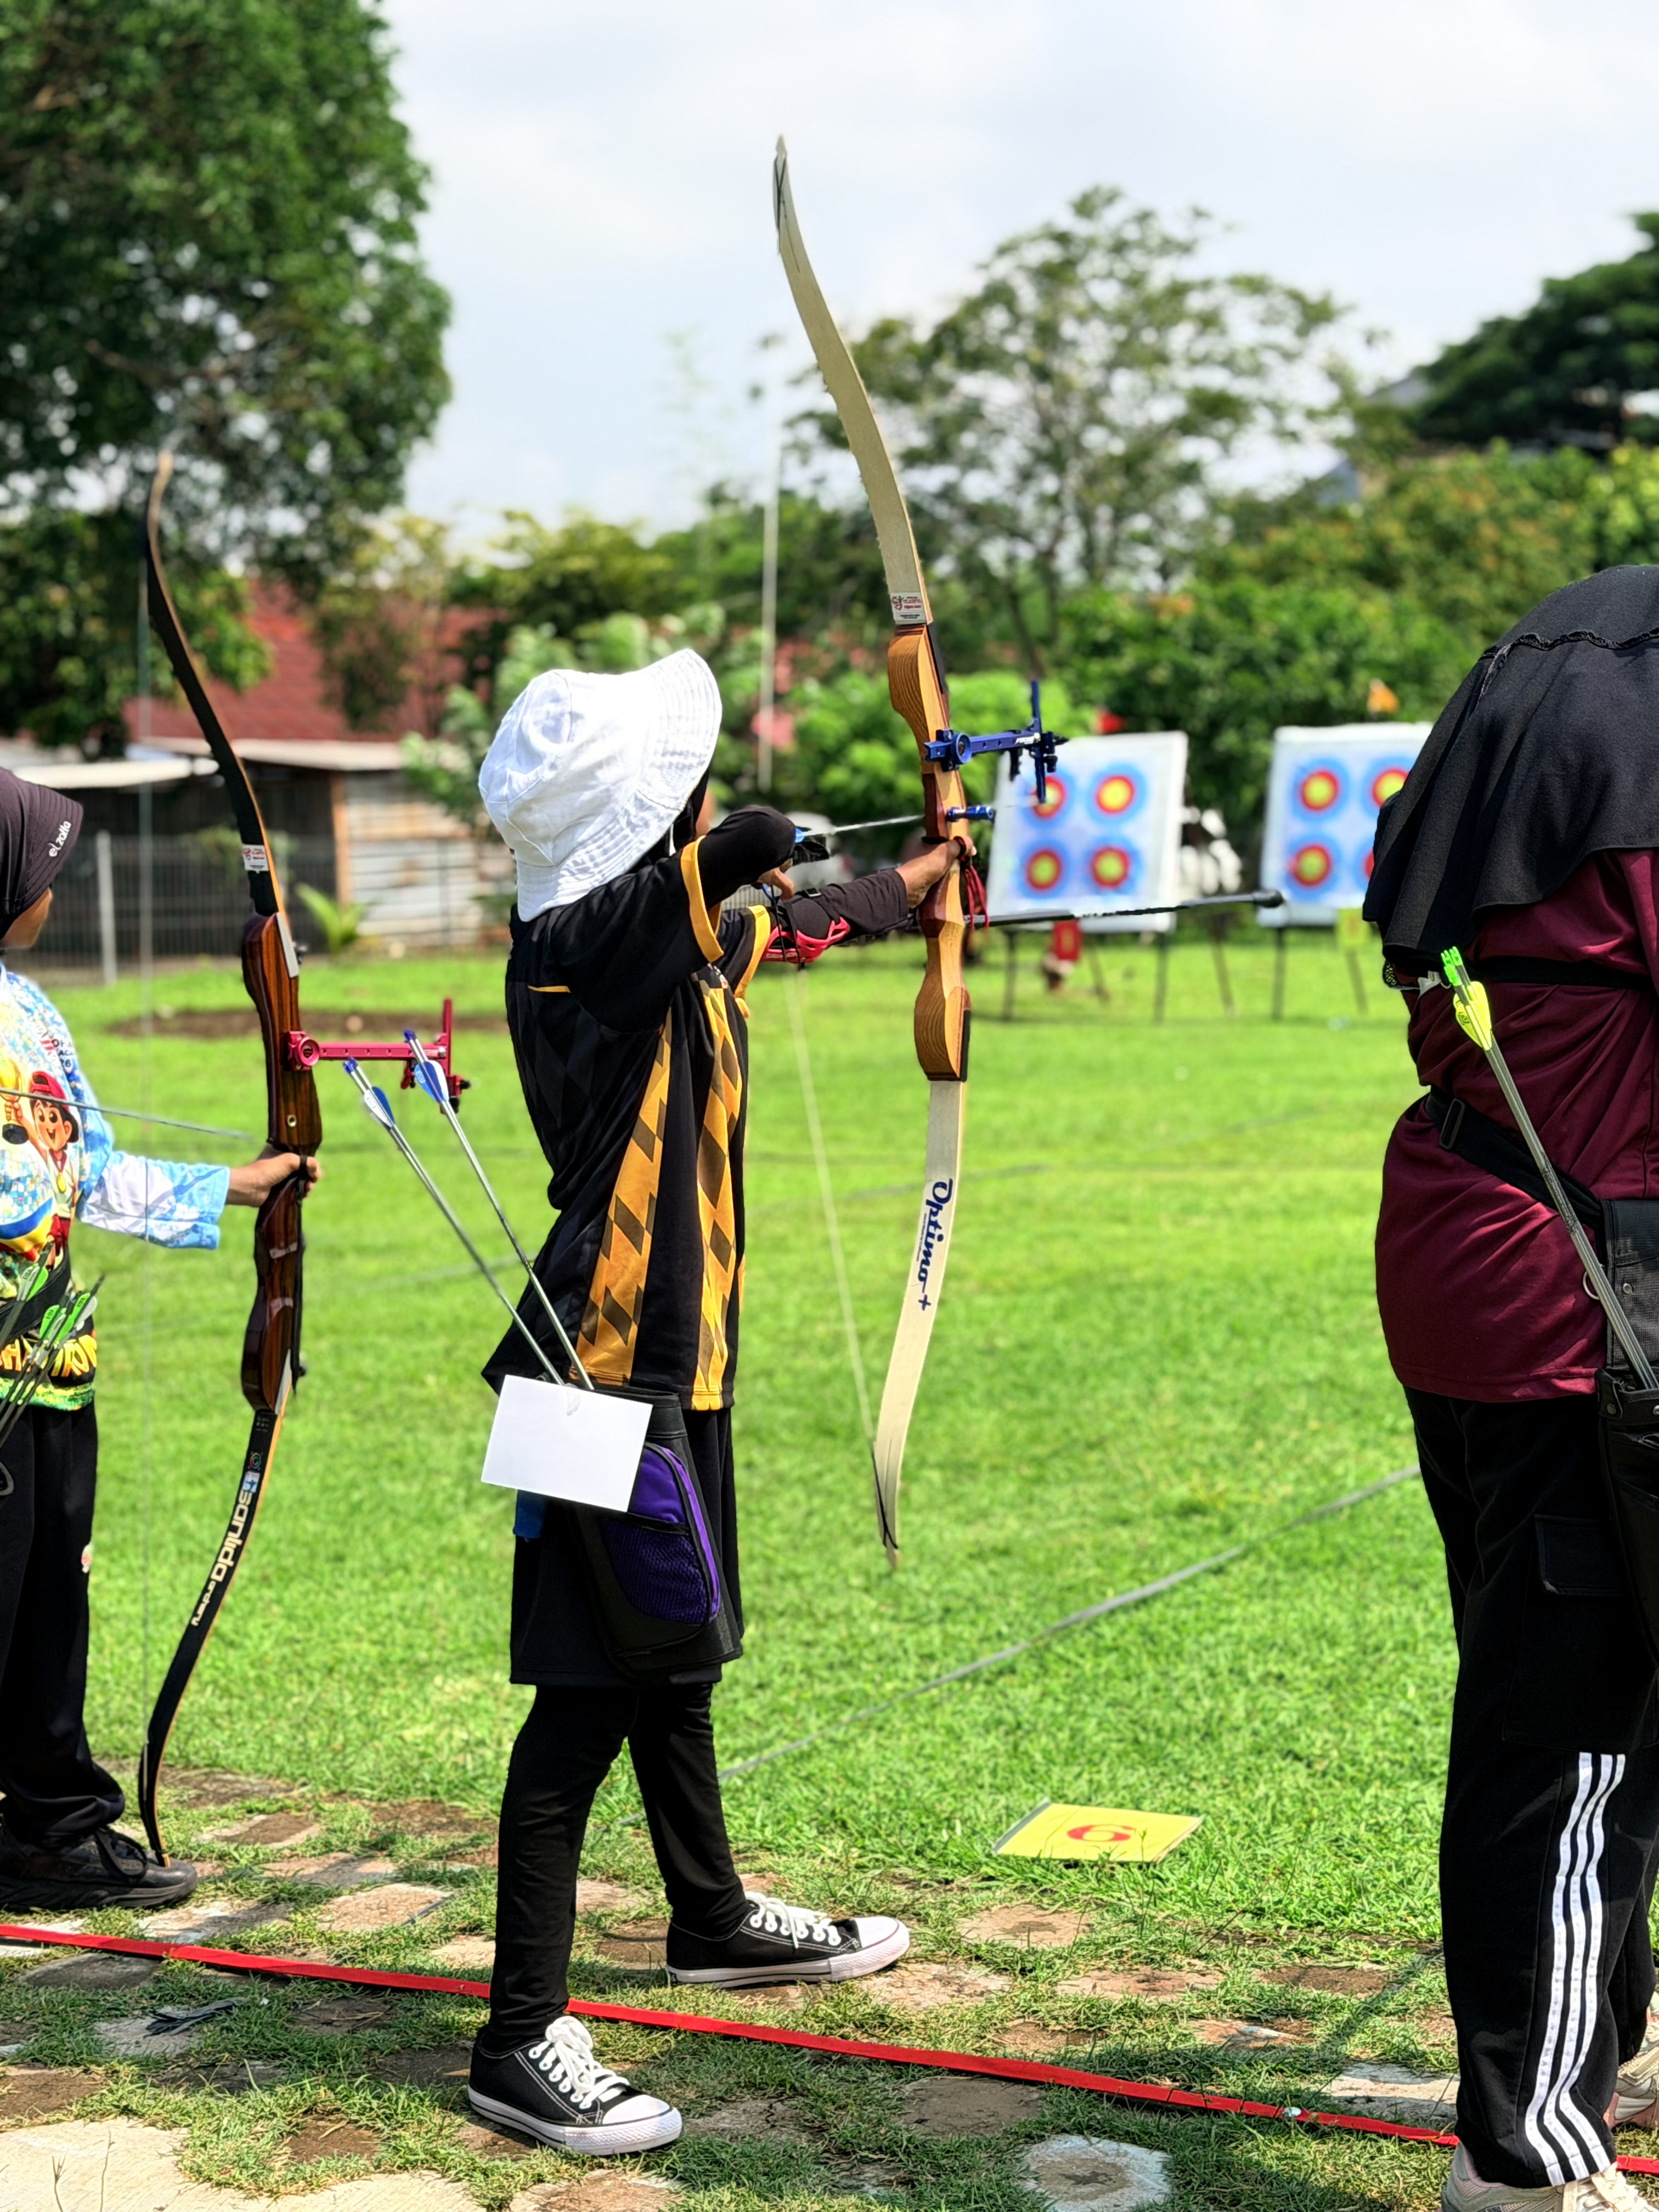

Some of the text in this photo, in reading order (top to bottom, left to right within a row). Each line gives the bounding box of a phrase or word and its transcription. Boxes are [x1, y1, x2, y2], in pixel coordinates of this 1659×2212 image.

[191, 1489, 252, 1626] sanlida archery
[1066, 1824, 1135, 1842] 6
